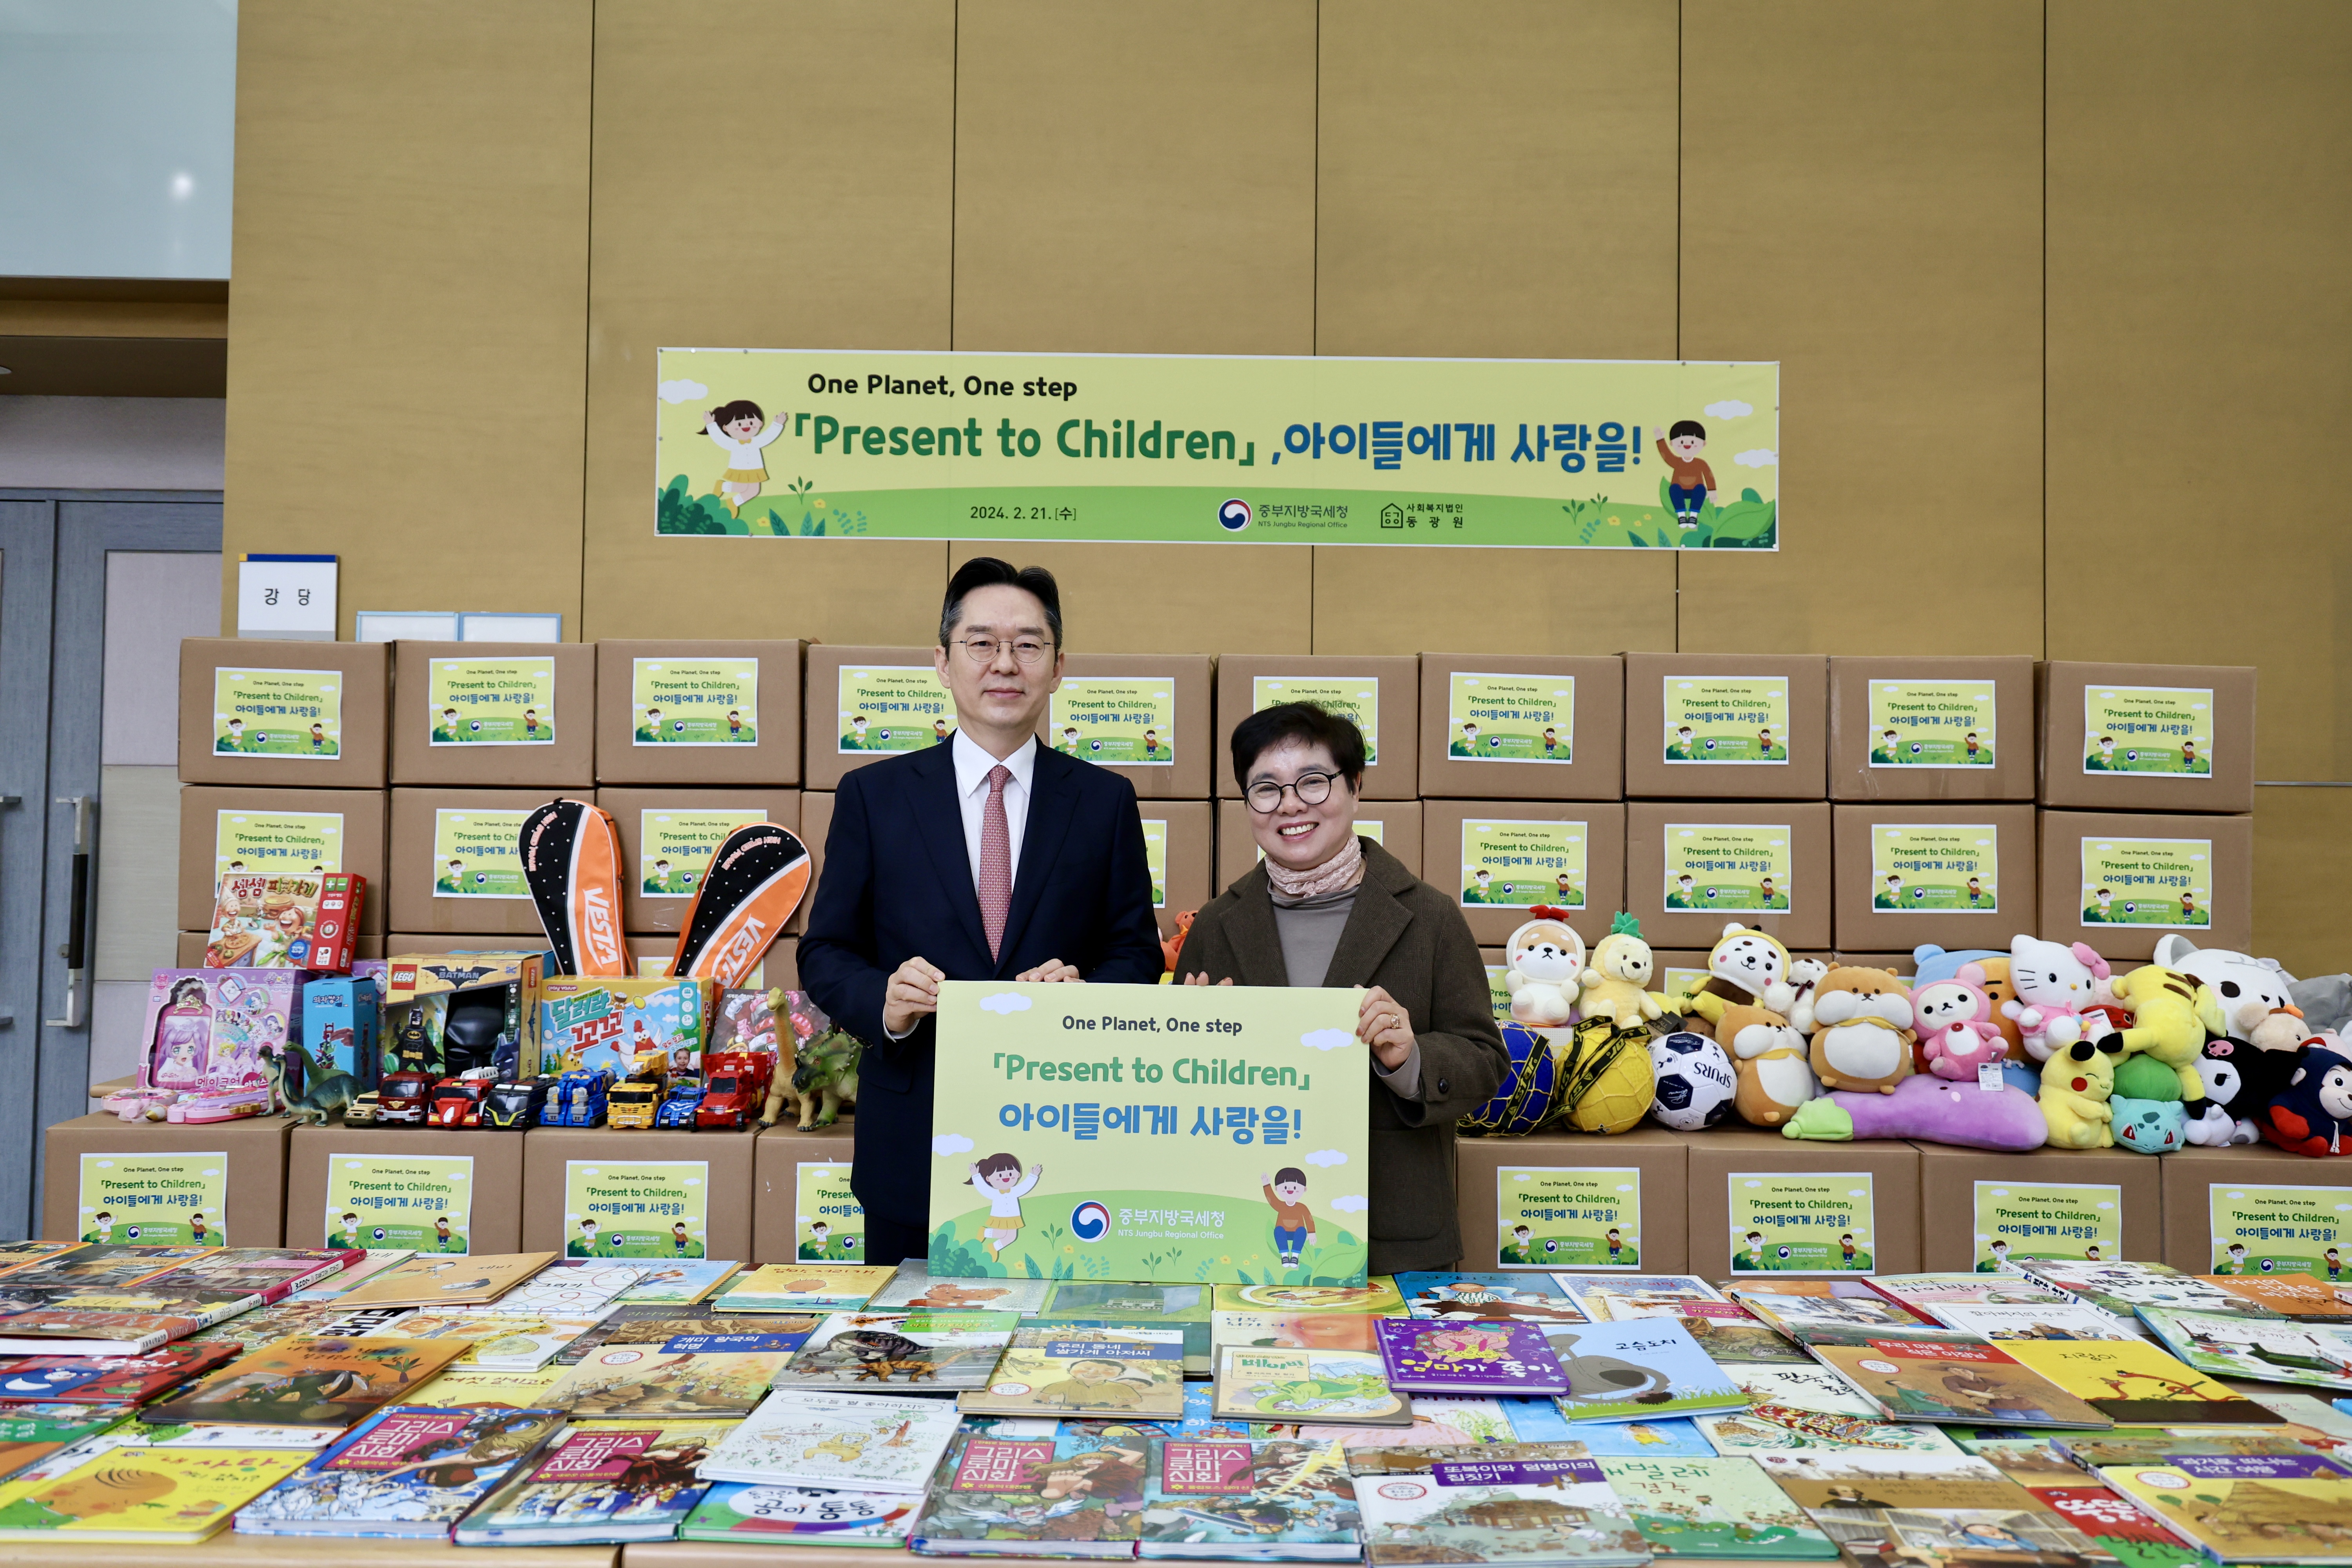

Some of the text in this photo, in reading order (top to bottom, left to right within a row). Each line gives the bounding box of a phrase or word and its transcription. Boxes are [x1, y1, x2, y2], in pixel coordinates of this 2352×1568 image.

[808, 374, 1077, 401] One Planet, One step
[996, 418, 1041, 457] to
[1510, 421, 1641, 473] 사랑을!
[970, 506, 1008, 519] 2024.
[1014, 507, 1025, 519] 2.
[1259, 505, 1348, 519] 중부지방국세청
[1406, 503, 1463, 513] 사회복지법인
[653, 694, 737, 705] 아이들에게 사랑을!
[528, 811, 558, 872] HIGH SPEED FRAME
[741, 838, 763, 852] SPEED
[721, 849, 742, 871] FRAME
[584, 887, 619, 965] VESTA
[715, 914, 766, 988] VESTA
[393, 971, 416, 982] LEGO
[505, 966, 517, 975] DC
[574, 994, 588, 1002] BOARD
[551, 992, 613, 1031] 달려라
[571, 1011, 623, 1051] 꼬꼬
[1062, 1015, 1242, 1036] One Planet, One step
[1132, 1057, 1163, 1083] to
[1693, 1062, 1733, 1088] SPURS
[999, 1103, 1301, 1145] 아이들에게 사랑을!
[147, 1180, 158, 1188] to
[103, 1194, 202, 1207] 아이들에게 사랑을!
[1119, 1209, 1224, 1227] 중부지방국세청
[2278, 1212, 2289, 1221] to
[1135, 1230, 1163, 1239] Jungbu
[1165, 1230, 1198, 1239] Regional
[2236, 1227, 2336, 1241] 아이들에게 사랑을!
[2086, 1278, 2216, 1290] 백과 사전
[1615, 1339, 1677, 1351] 고슴도치
[1941, 1350, 1988, 1359] 이장님
[2059, 1352, 2118, 1361] 지렁이
[1401, 1359, 1554, 1377] 엄마가 좋아
[864, 1402, 926, 1410] 좋아하지?
[389, 1420, 456, 1434] 그리스
[360, 1432, 422, 1445] 로마
[577, 1436, 644, 1448] 그리스
[345, 1444, 407, 1457] 신화
[559, 1446, 613, 1460] 로마
[972, 1447, 1046, 1459] 그리스
[1170, 1448, 1251, 1461] 그리스
[544, 1458, 603, 1471] 신화
[965, 1458, 1020, 1470] 로마
[1168, 1459, 1222, 1472] 로마
[1443, 1461, 1595, 1474] 또복이와 덤벙이의
[961, 1469, 1016, 1482] 신화
[1167, 1470, 1222, 1483] 신화
[1446, 1472, 1501, 1482] 집짓기
[1638, 1480, 1691, 1494] 경주
[754, 1499, 875, 1520] 공이 통통
